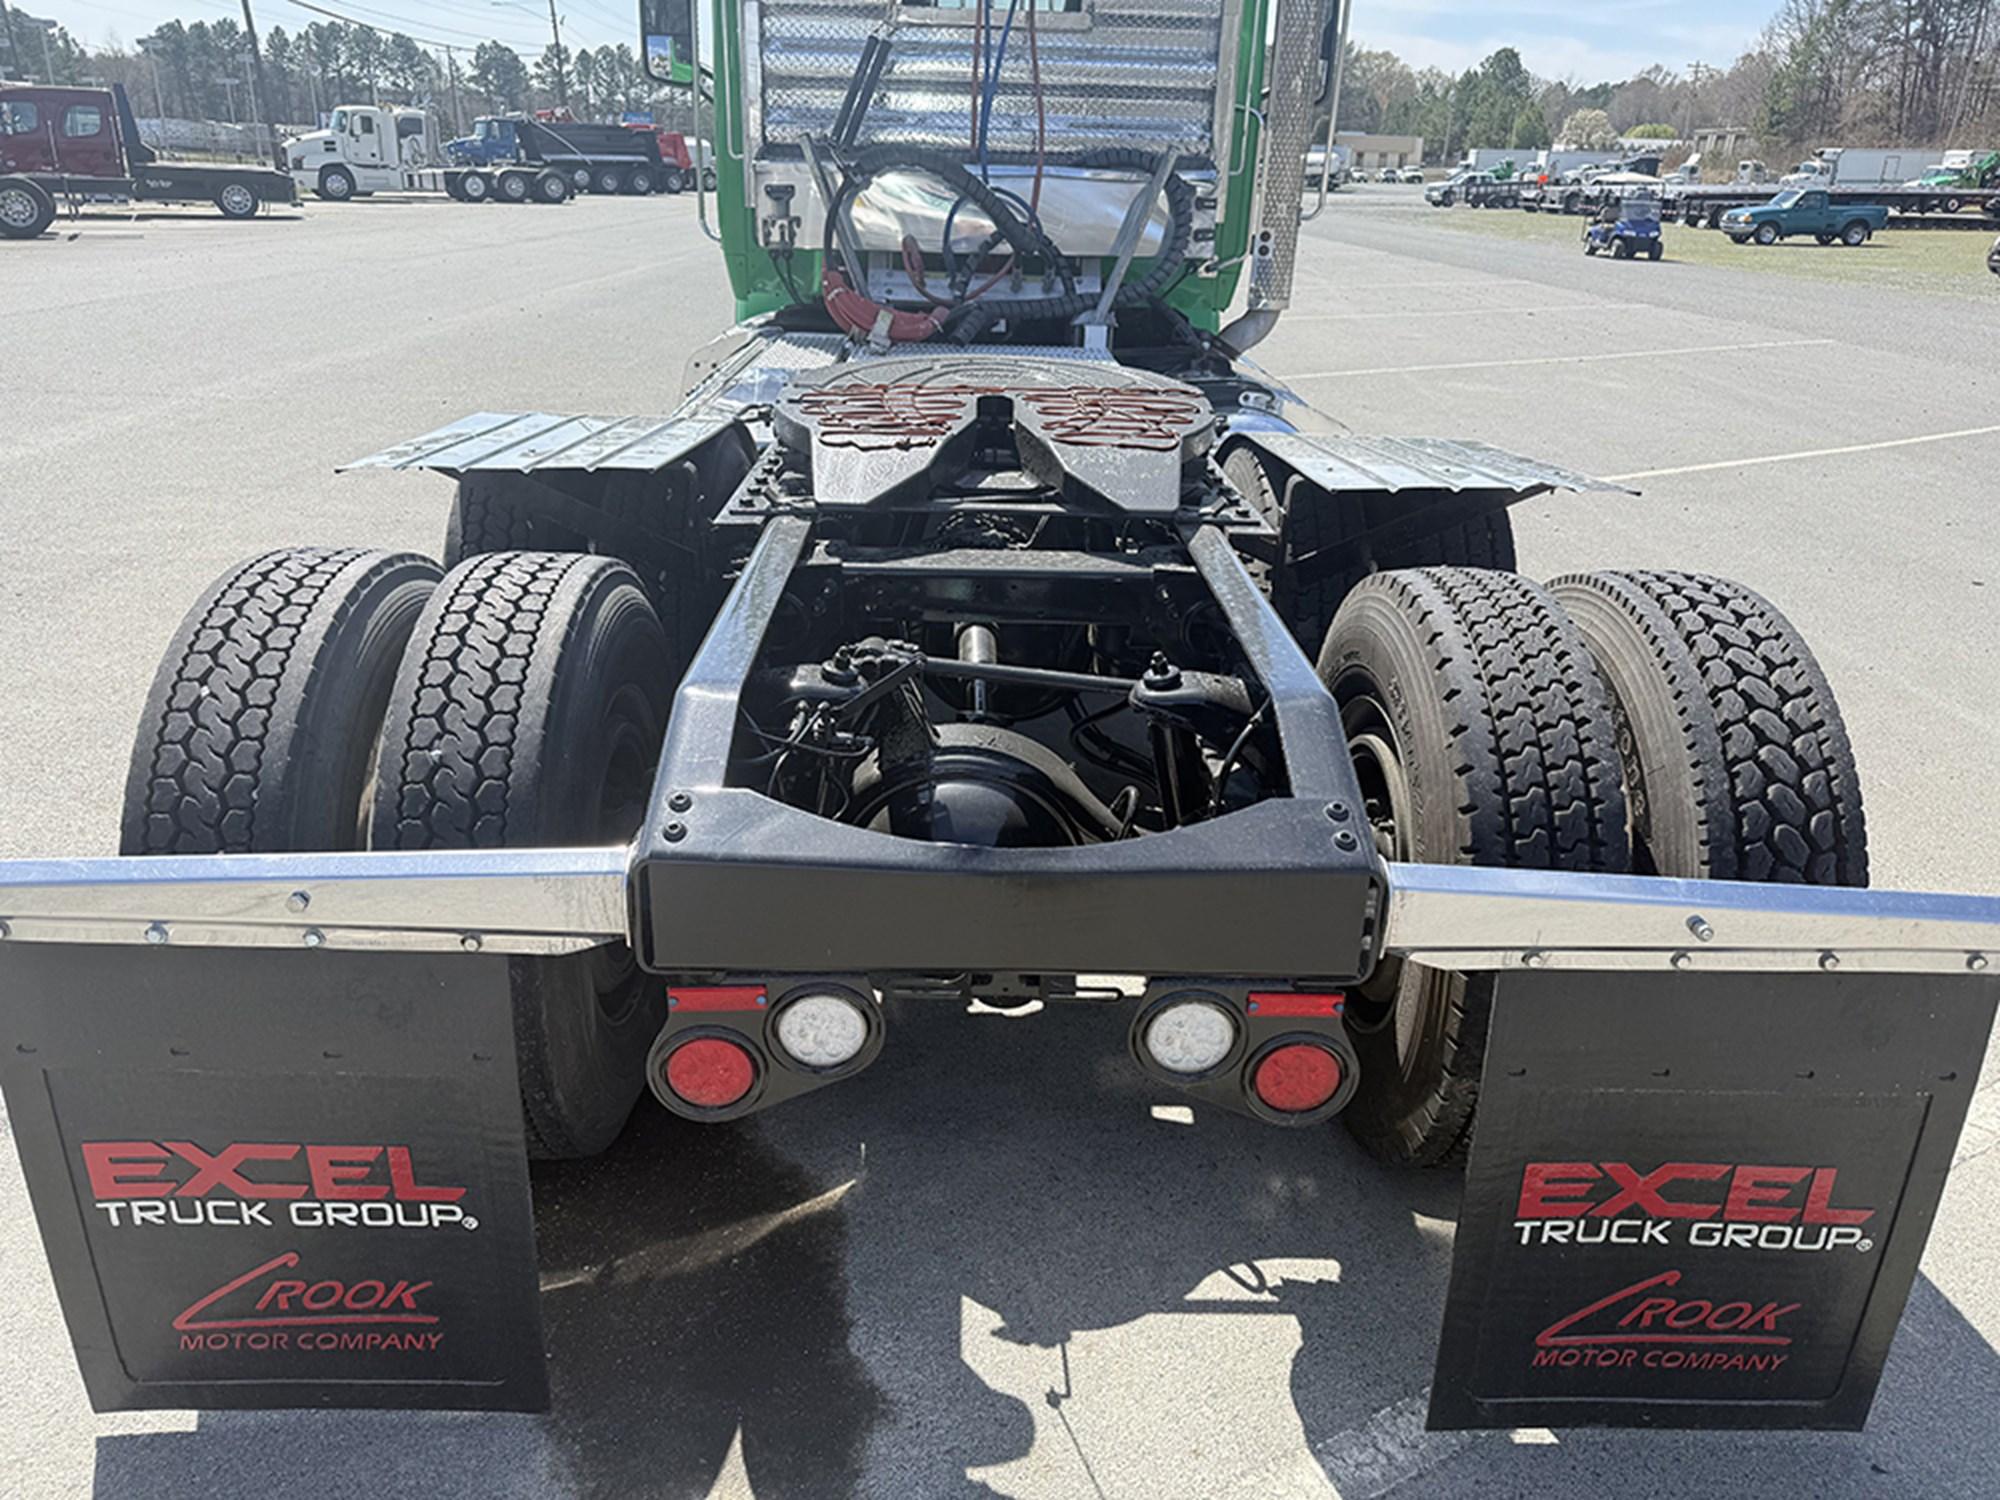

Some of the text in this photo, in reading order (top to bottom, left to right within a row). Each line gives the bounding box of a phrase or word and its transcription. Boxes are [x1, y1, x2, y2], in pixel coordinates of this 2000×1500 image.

[81, 1141, 466, 1202] EXCEL
[1516, 1162, 1875, 1225] EXCEL
[95, 1200, 273, 1227] TRUCK
[1513, 1219, 1672, 1246] TRUCK
[172, 1251, 439, 1331] CROOK
[1535, 1270, 1801, 1347] CROOK
[179, 1332, 444, 1352] MOTOR COMPANY
[1531, 1347, 1789, 1373] MOTOR COMPANY
